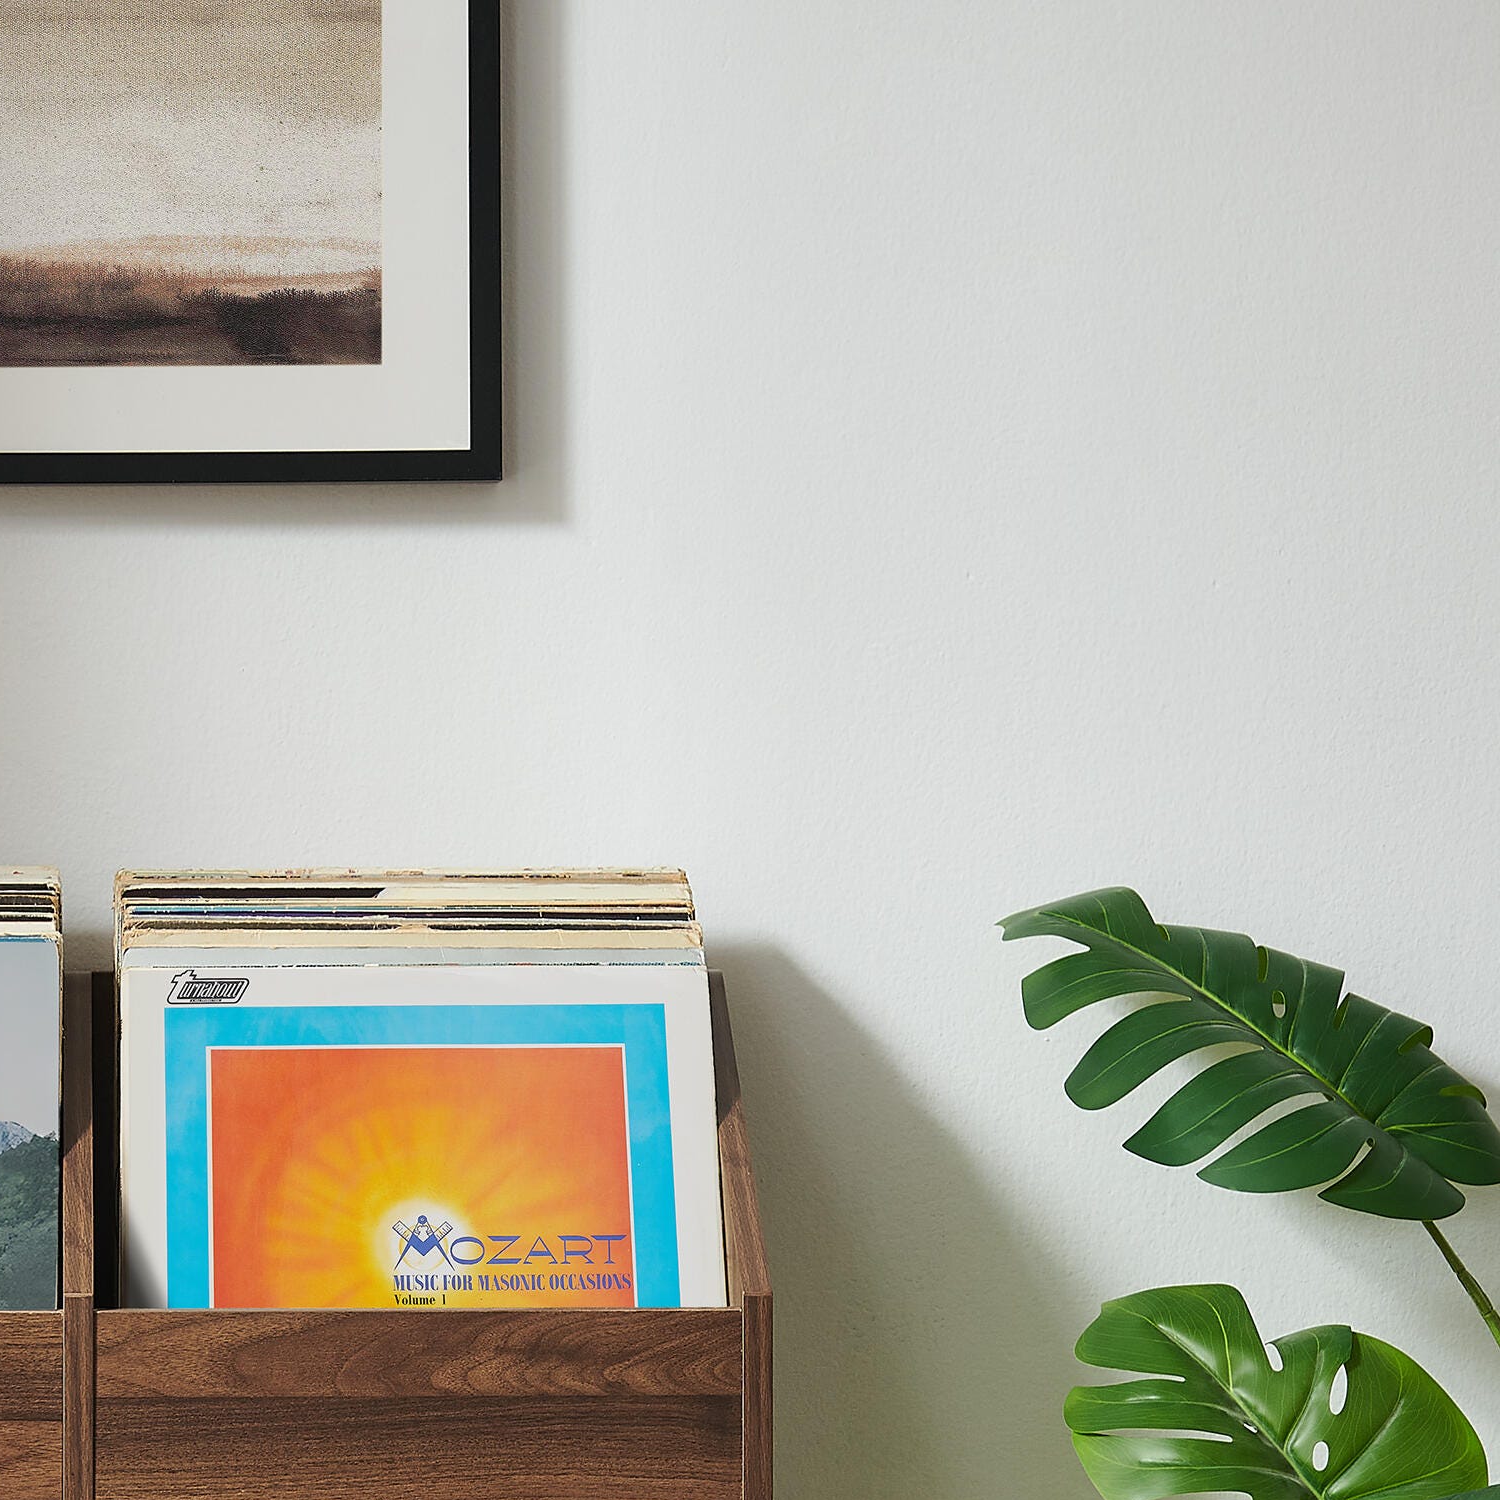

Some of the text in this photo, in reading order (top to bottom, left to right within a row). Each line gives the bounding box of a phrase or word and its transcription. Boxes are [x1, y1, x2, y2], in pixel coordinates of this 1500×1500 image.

[393, 1215, 627, 1271] MOZART
[393, 1273, 632, 1291] MUSIC FOR MASONIC OCCASIONS
[394, 1294, 447, 1306] Volume 1
